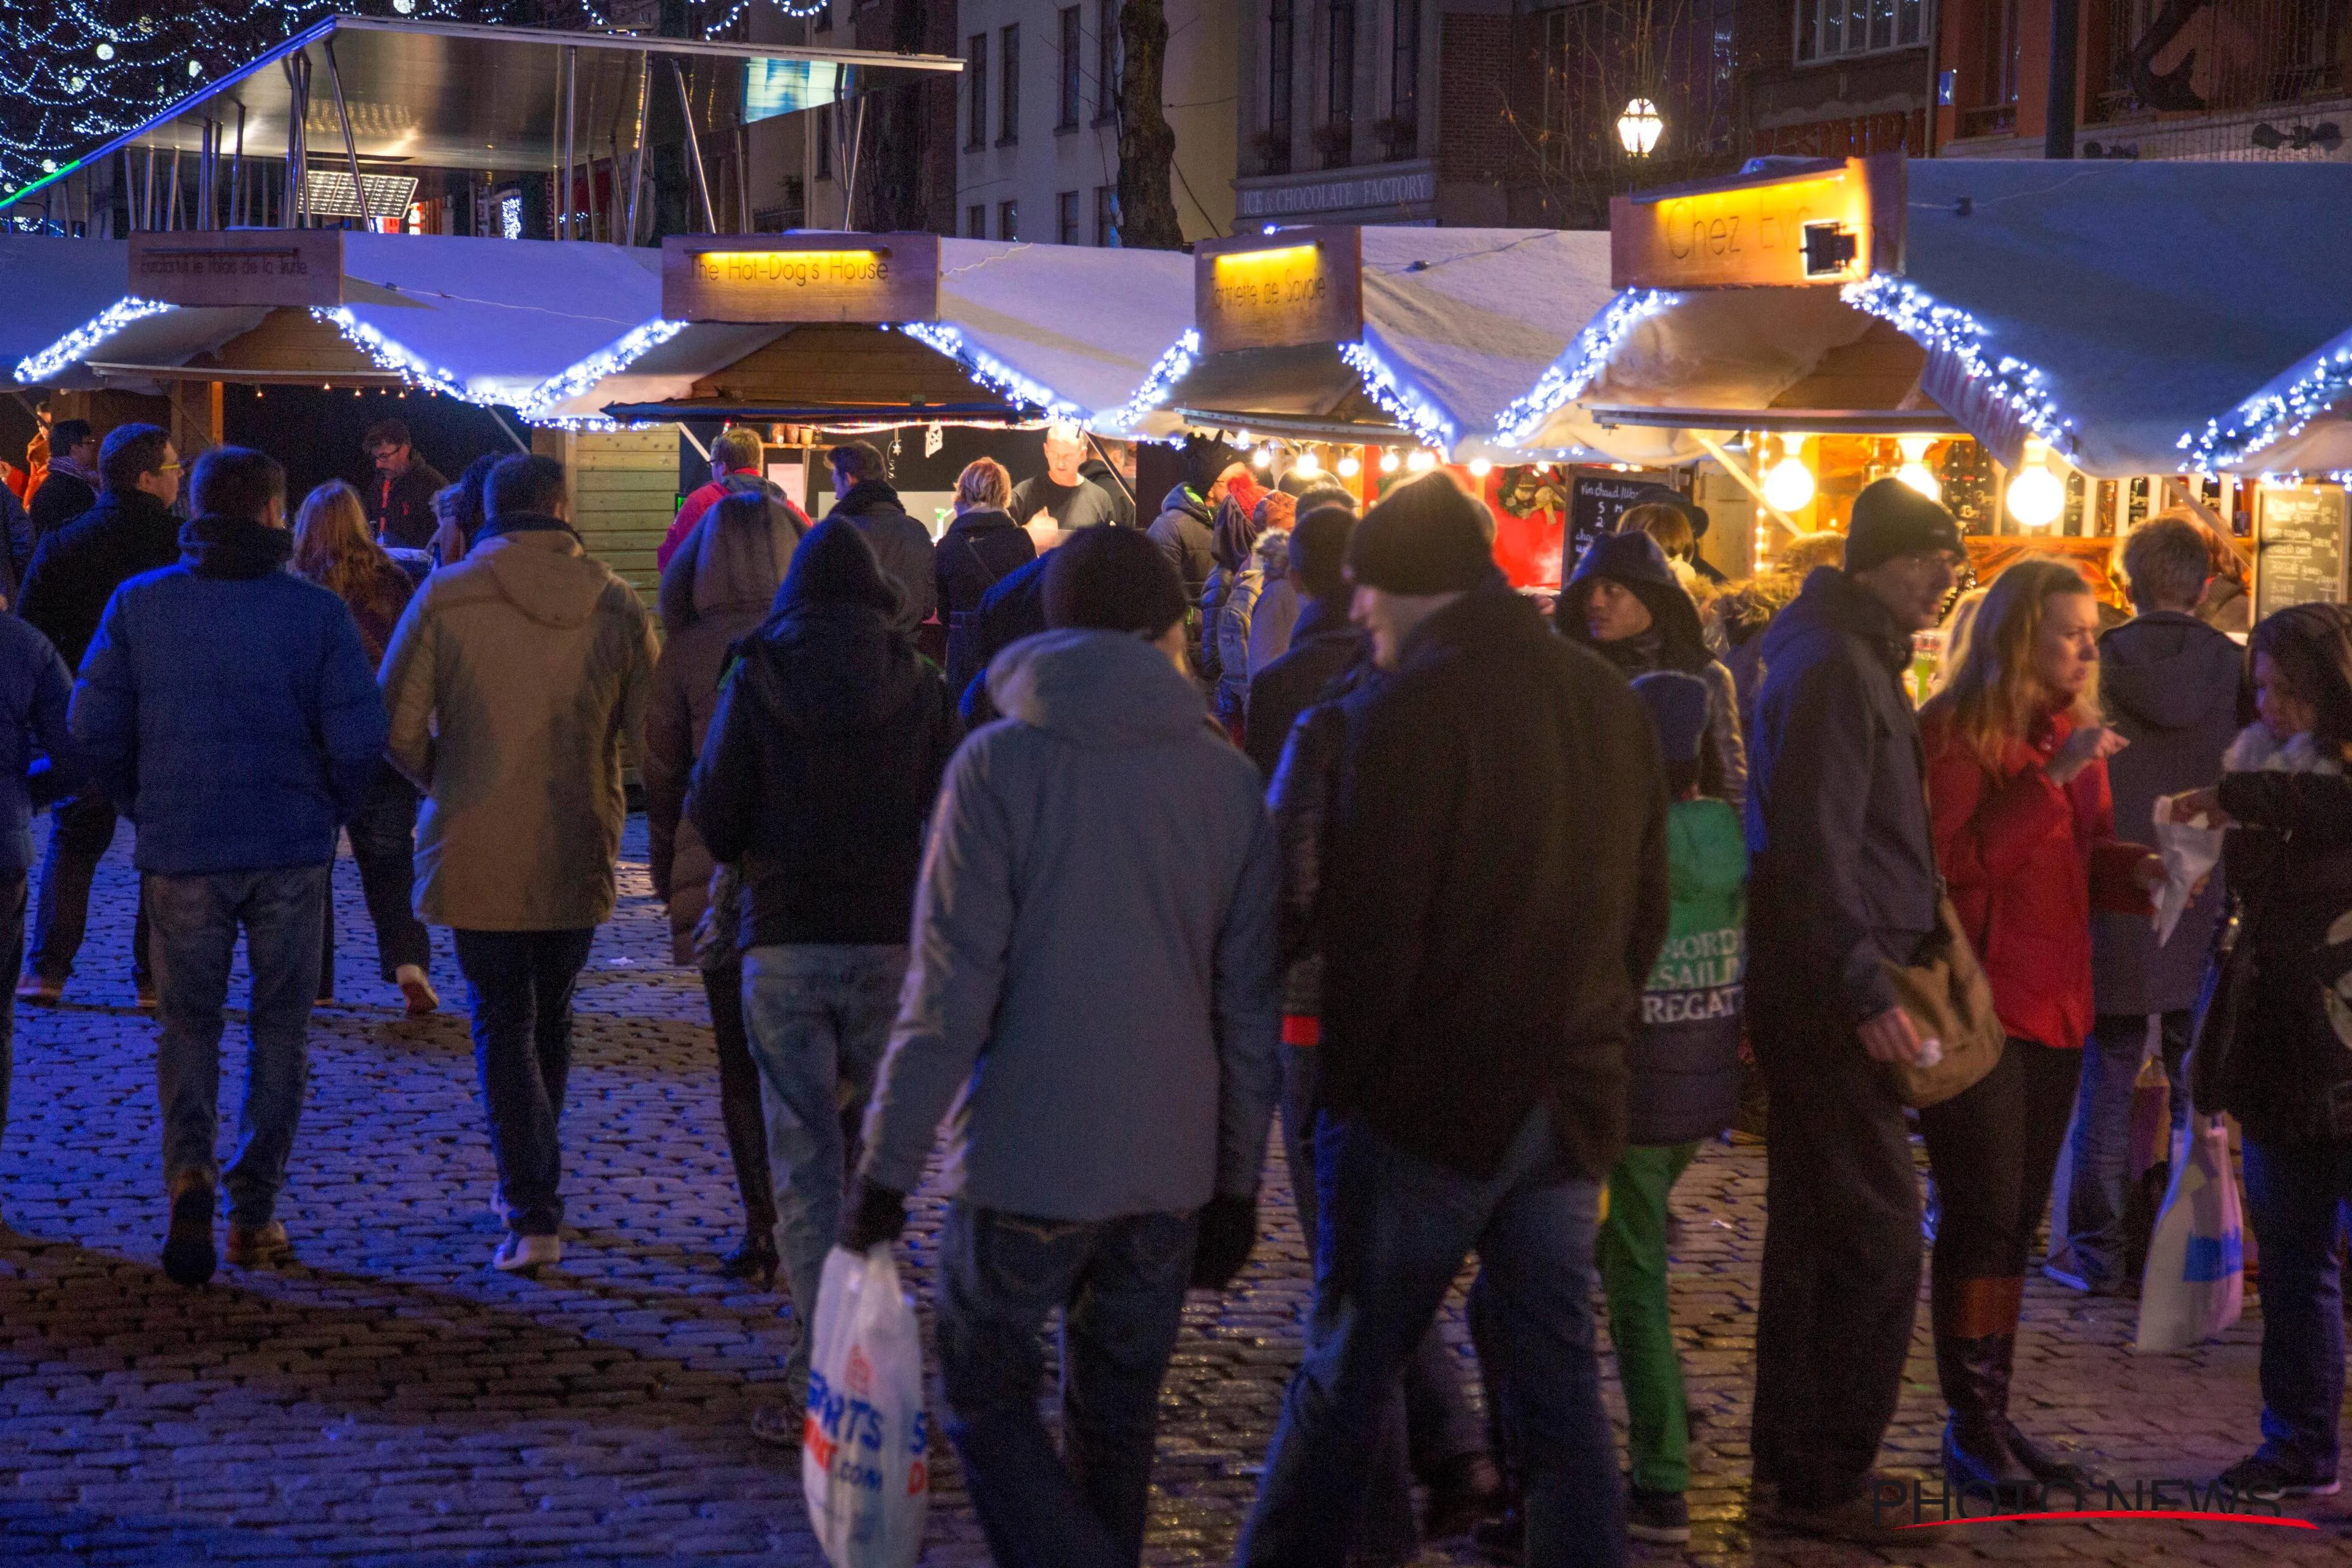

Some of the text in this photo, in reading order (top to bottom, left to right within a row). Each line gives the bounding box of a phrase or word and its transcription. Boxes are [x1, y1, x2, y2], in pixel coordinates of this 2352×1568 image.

[1244, 174, 1427, 214] ICE & CHOCOLATE FACTORY
[1667, 200, 1741, 260] Chez
[688, 253, 719, 281] The
[829, 254, 889, 280] House
